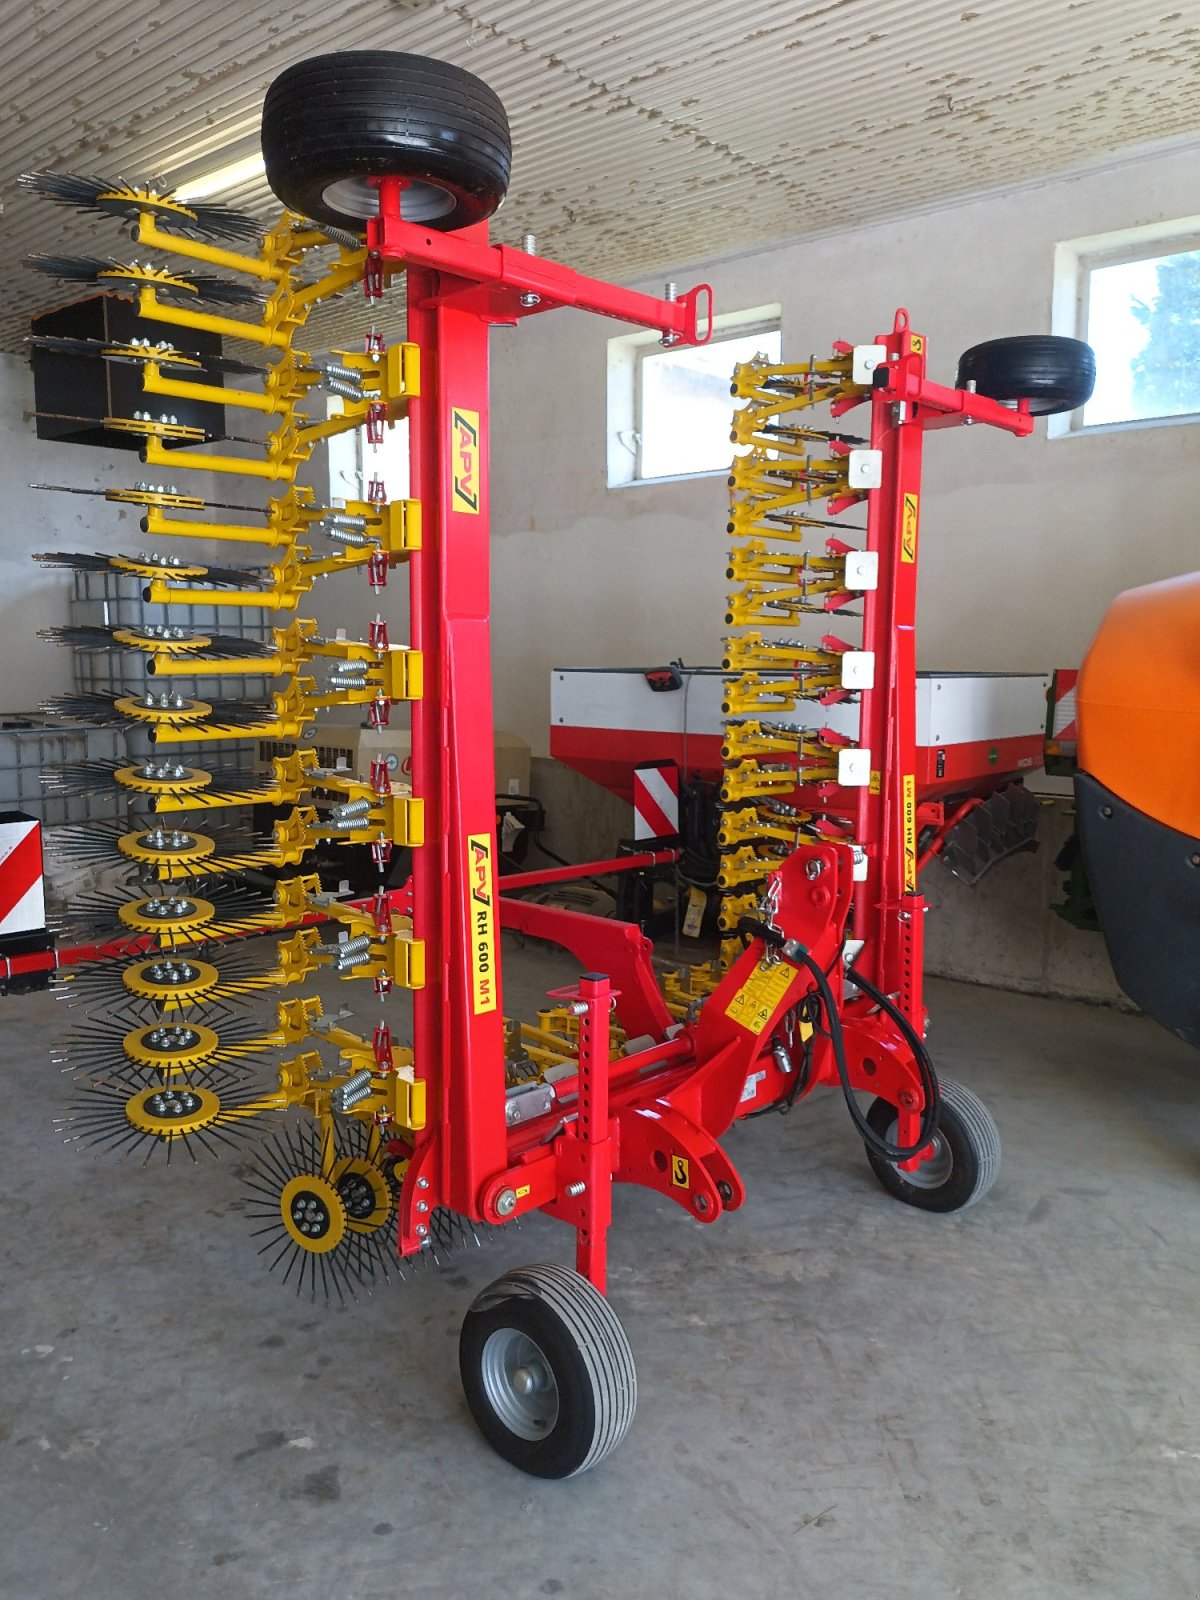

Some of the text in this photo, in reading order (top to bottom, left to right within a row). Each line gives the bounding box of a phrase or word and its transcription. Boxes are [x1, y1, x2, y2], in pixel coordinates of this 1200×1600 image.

[457, 421, 474, 502] APV
[906, 827, 912, 844] RH
[473, 844, 491, 1005] APV RH 600 M1
